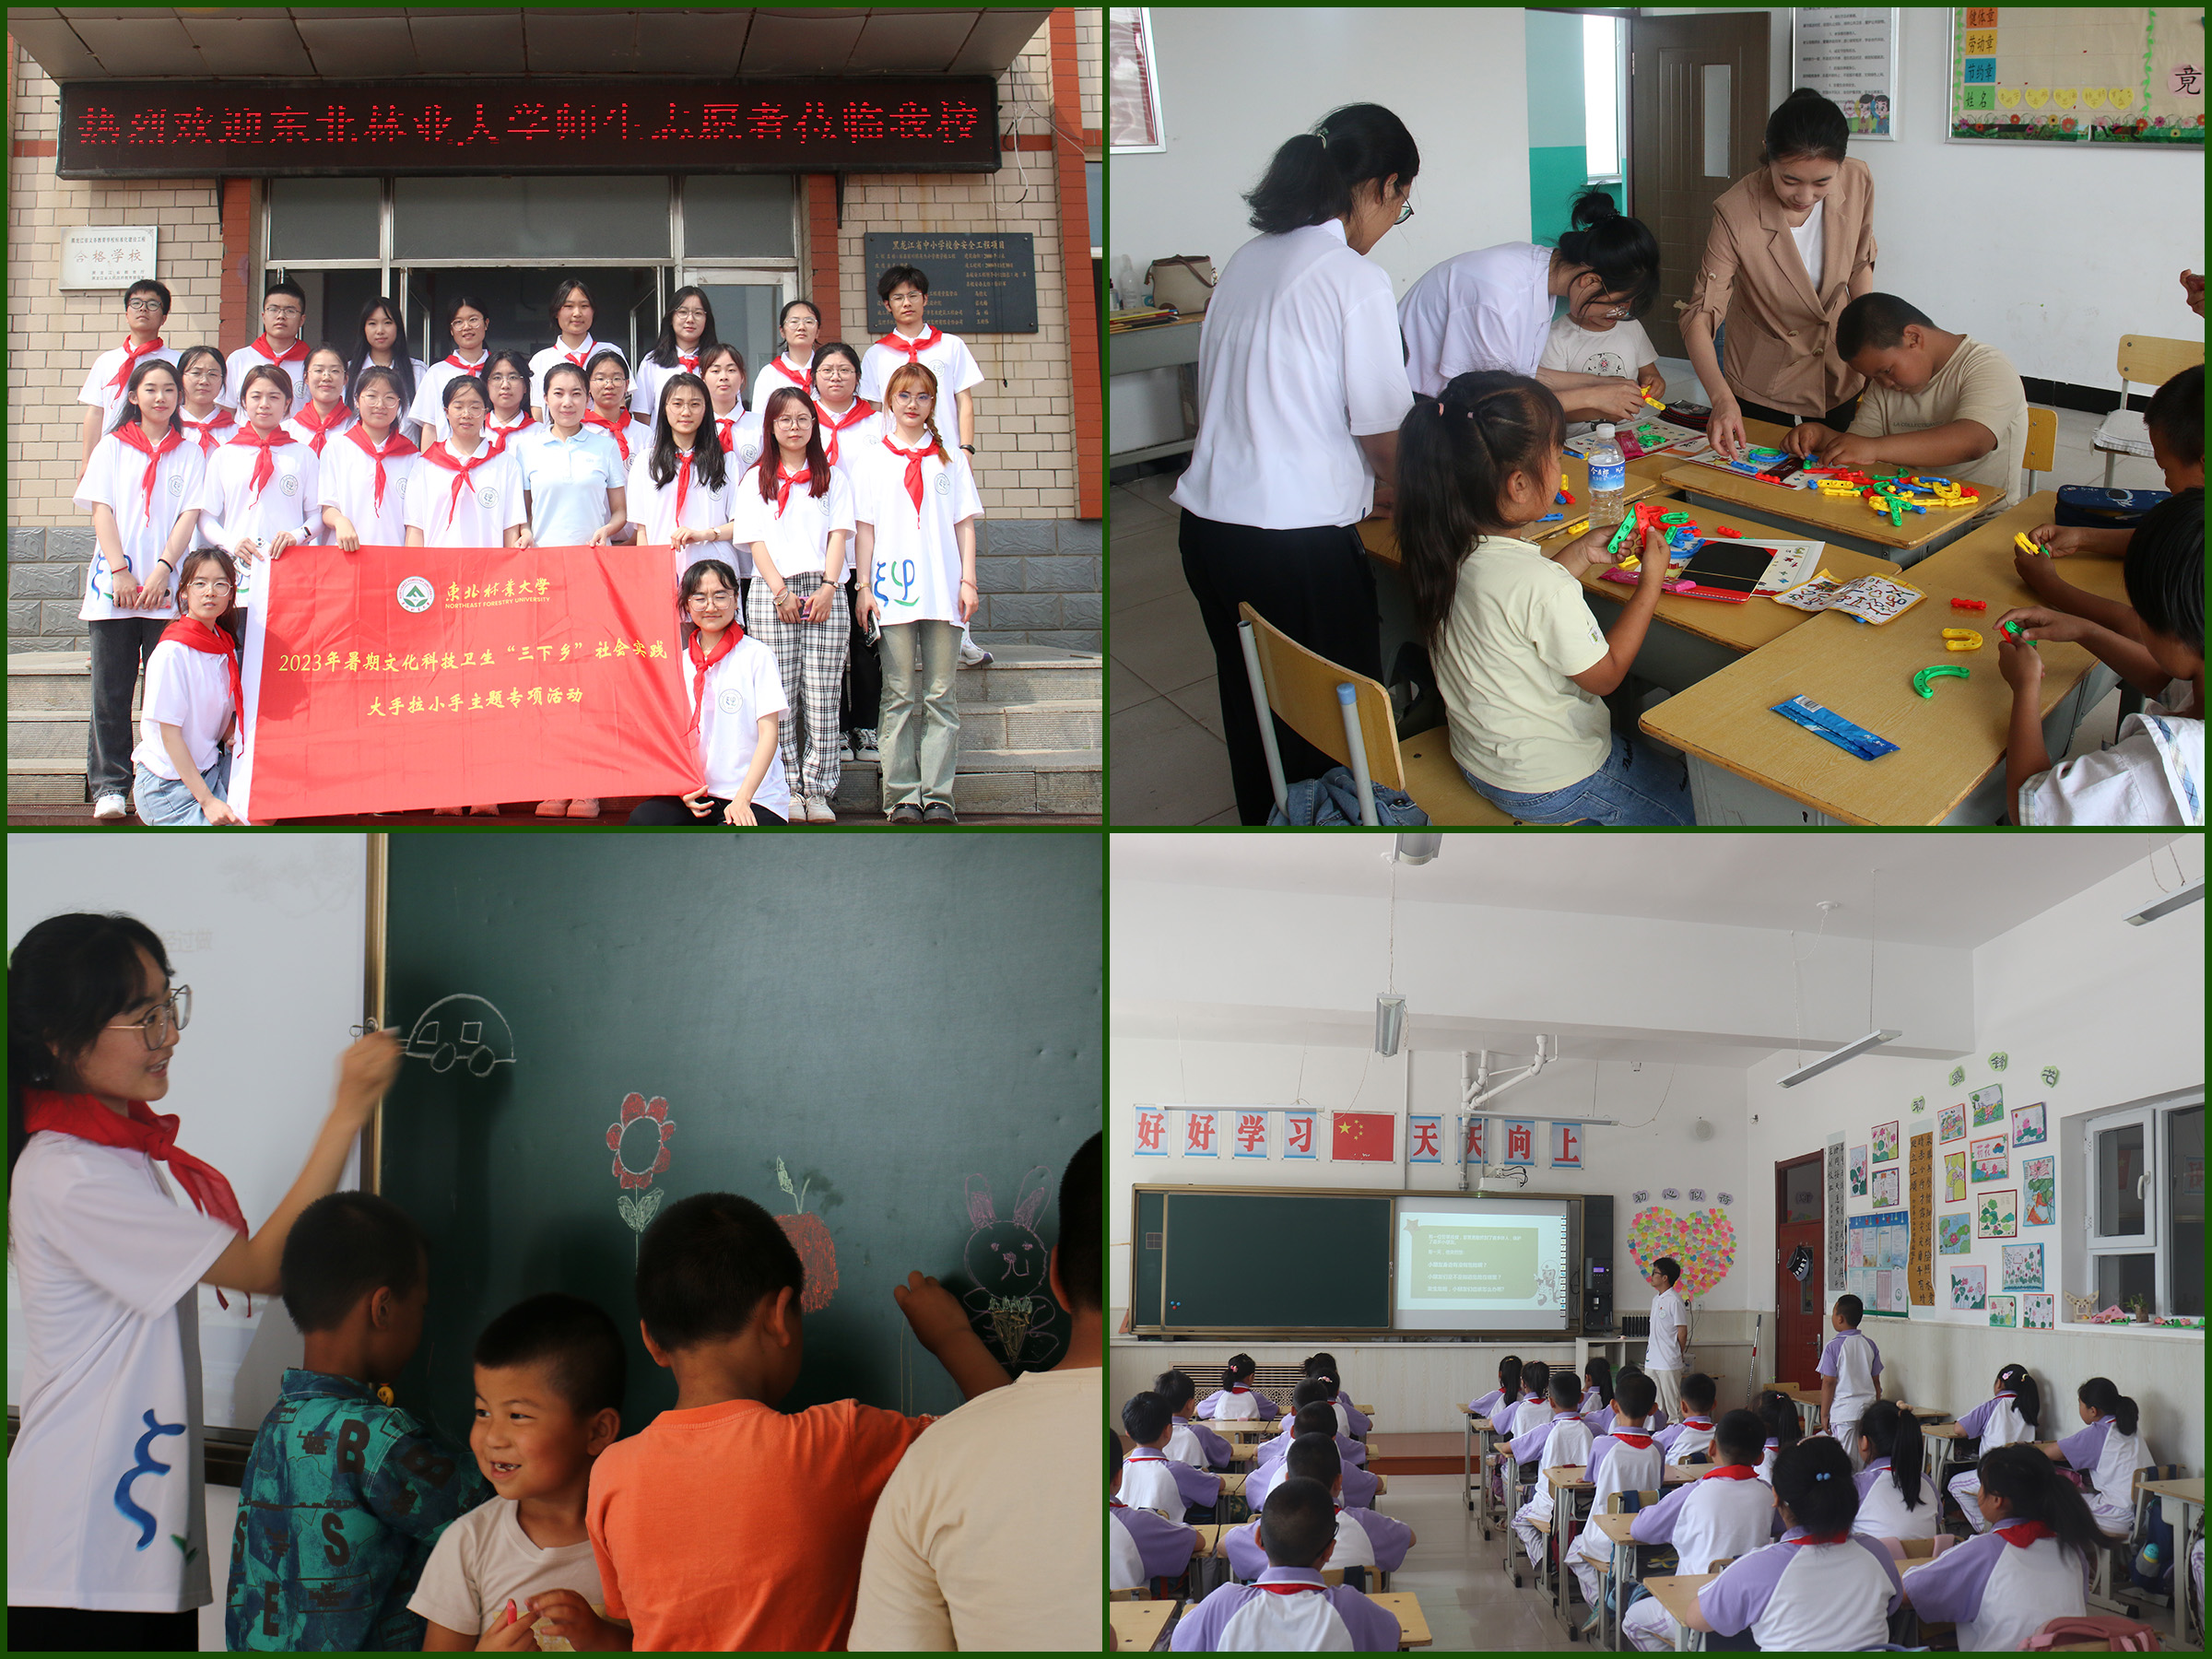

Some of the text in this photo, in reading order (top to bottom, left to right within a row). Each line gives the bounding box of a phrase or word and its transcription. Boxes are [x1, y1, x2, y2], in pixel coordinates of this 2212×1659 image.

[74, 248, 143, 263] 合格学校
[892, 240, 1005, 250] 黑龙江省中小学校舍安全工程项目
[445, 601, 481, 609] NORTHEAST
[483, 598, 513, 607] FORESTRY
[367, 687, 583, 717] 大手拉小手主题专项活动
[1137, 1112, 1313, 1153] 好好学习
[1413, 1122, 1580, 1162] 天天向上
[1635, 1190, 1731, 1205] 初心似荷
[322, 1512, 350, 1568] S
